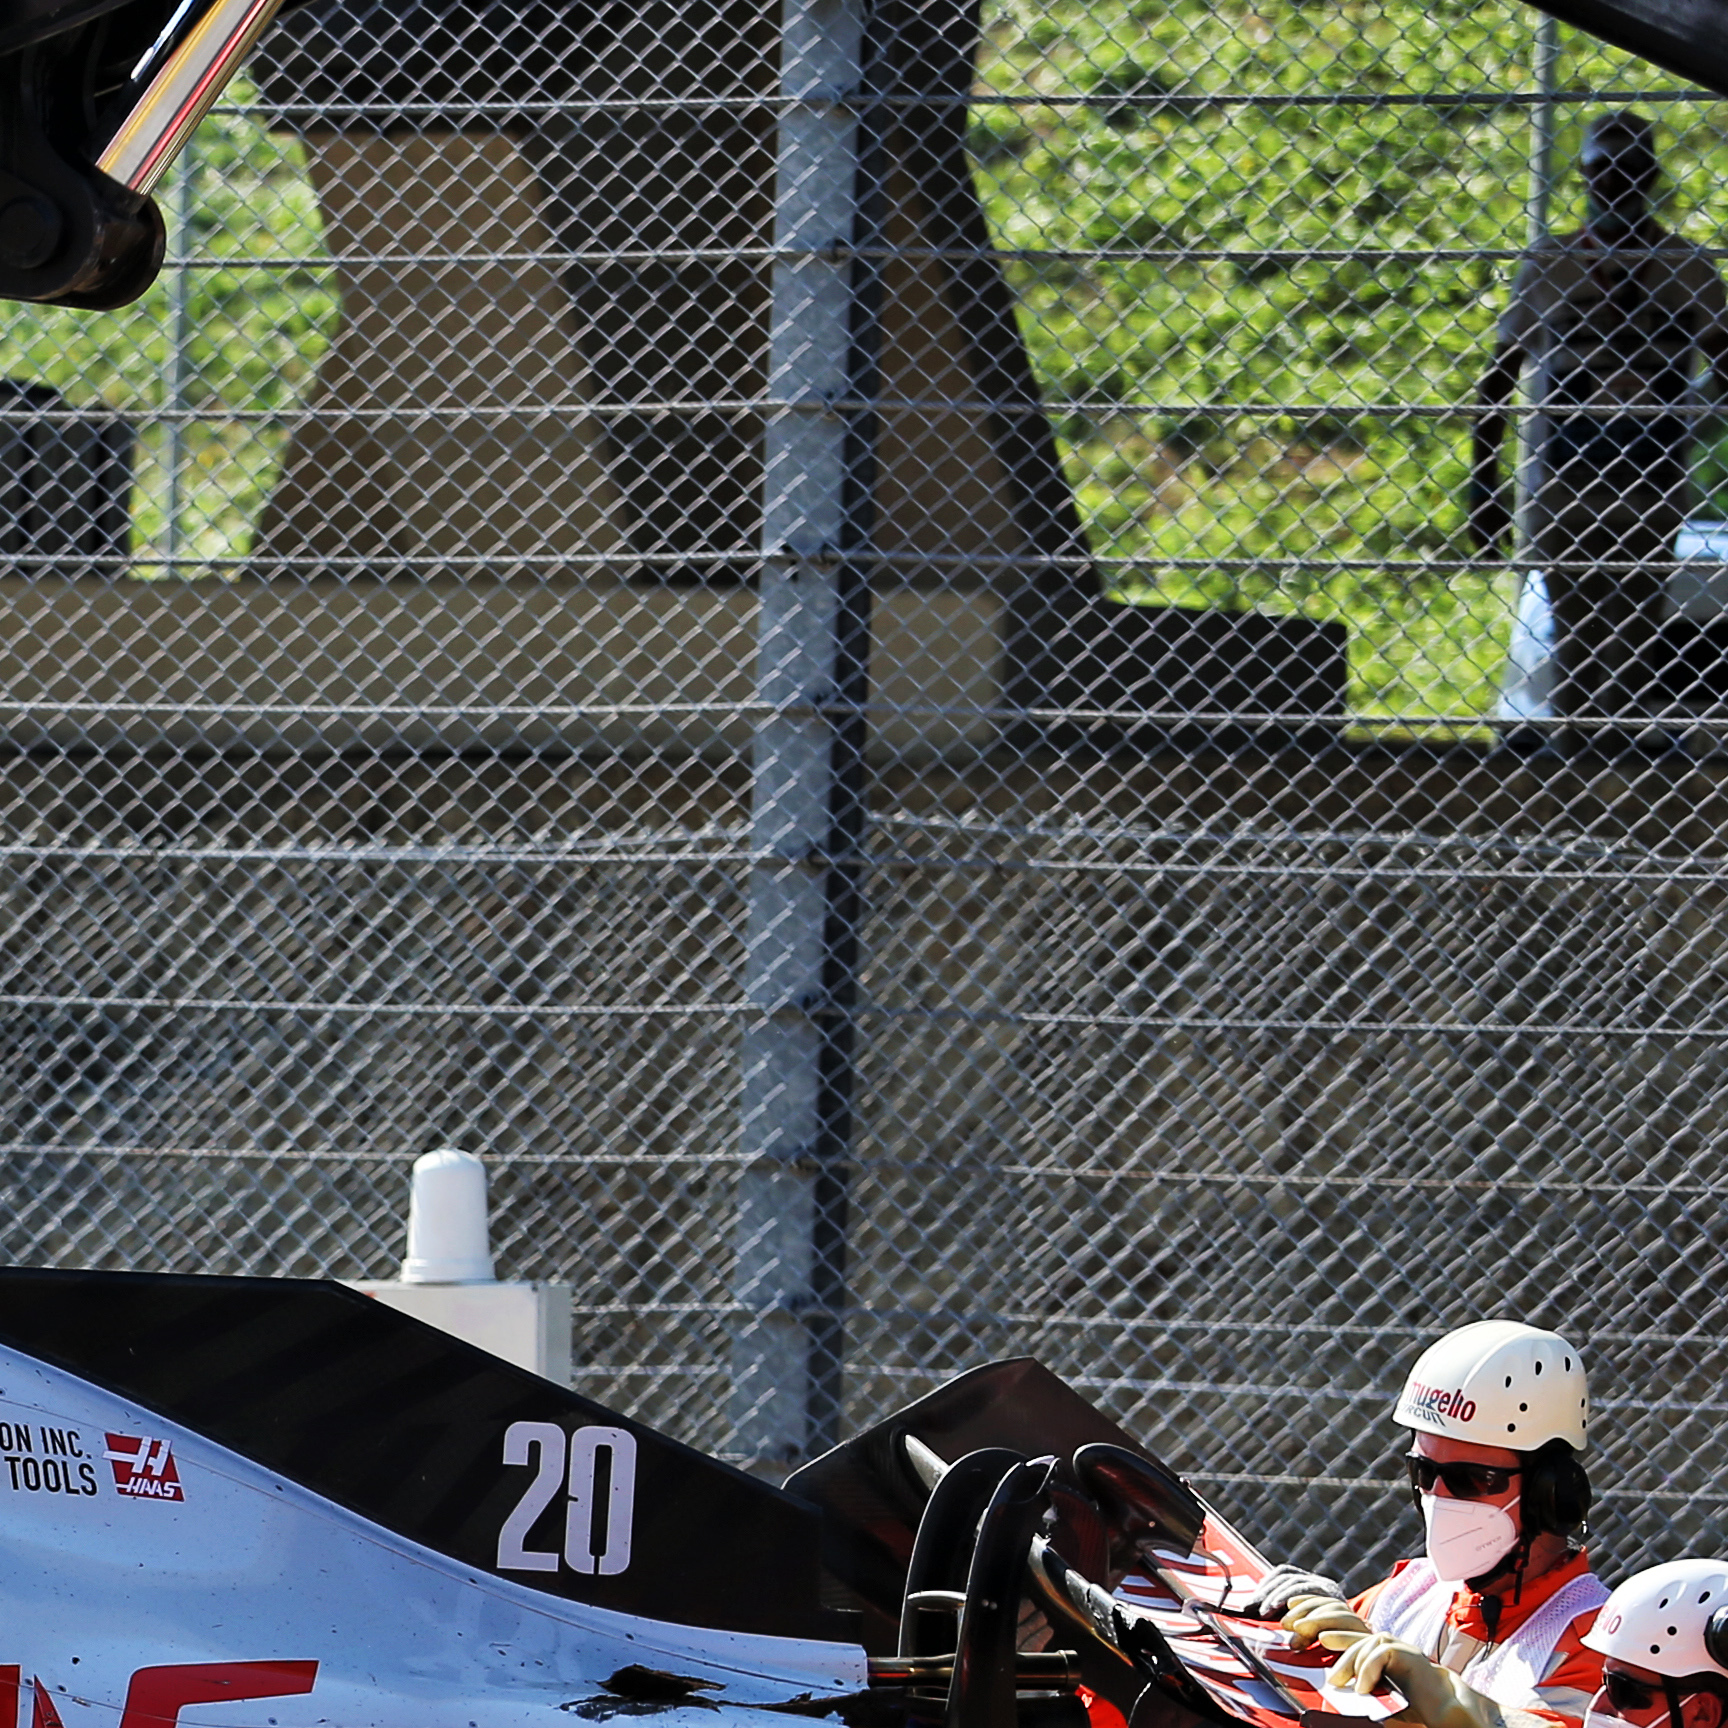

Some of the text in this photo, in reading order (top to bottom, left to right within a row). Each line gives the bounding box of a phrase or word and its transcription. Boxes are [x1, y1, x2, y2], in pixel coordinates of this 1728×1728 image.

[1408, 1381, 1477, 1423] mugello
[40, 1426, 93, 1458] INC.
[4, 1457, 98, 1497] TOOLS
[116, 1477, 181, 1498] HAAS
[496, 1420, 638, 1575] 20
